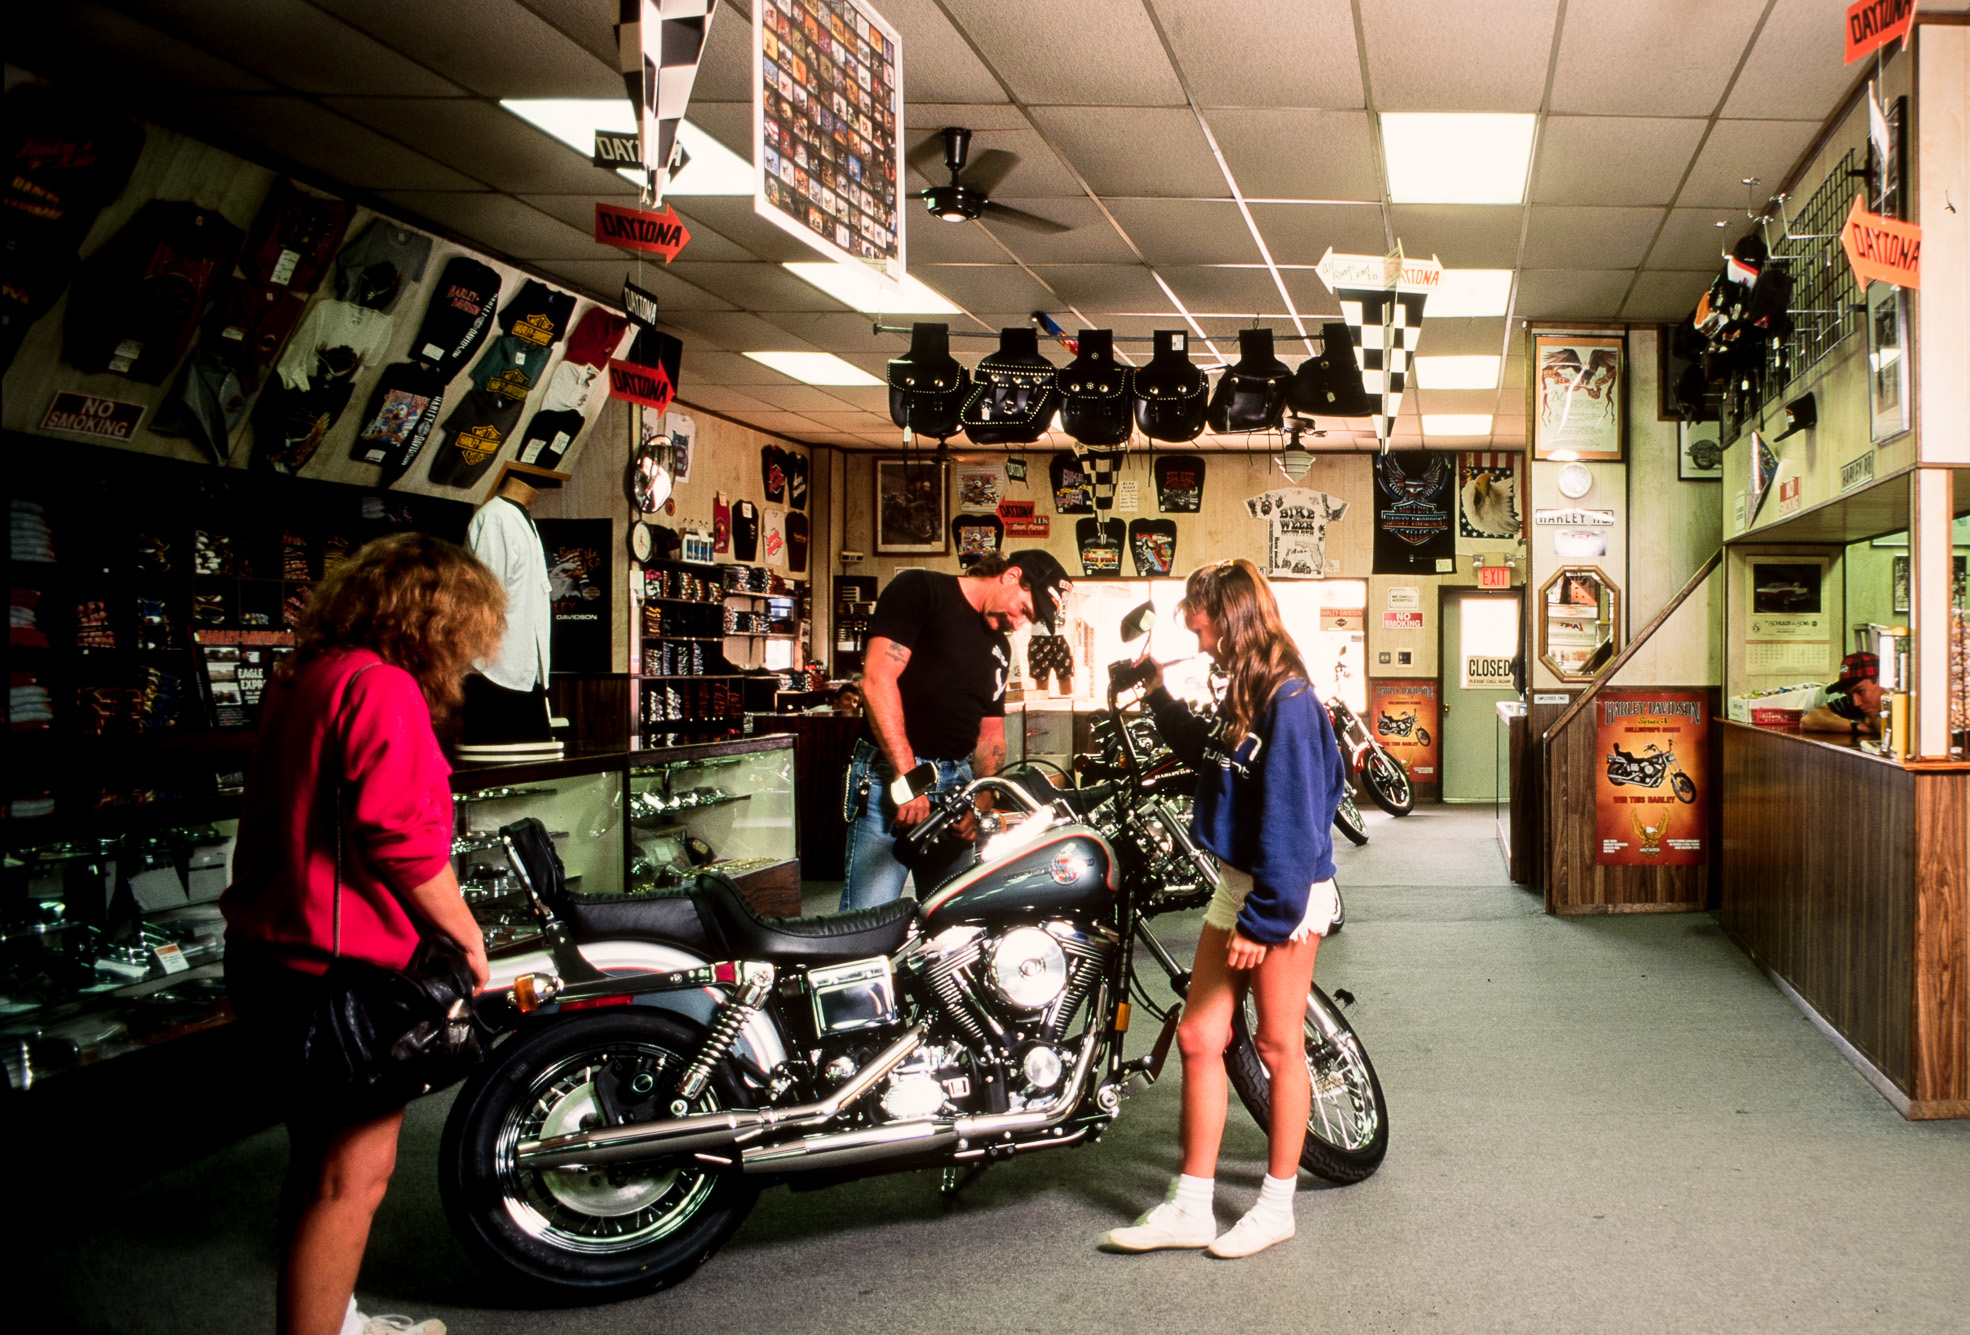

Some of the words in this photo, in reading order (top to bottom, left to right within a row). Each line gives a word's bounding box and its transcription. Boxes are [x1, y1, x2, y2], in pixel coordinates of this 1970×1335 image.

[1850, 0, 1912, 45] DAYTONA
[596, 136, 683, 167] DAYTA
[599, 212, 683, 247] DAYTONA
[1852, 222, 1921, 272] DAYTONA
[624, 286, 658, 326] DAYTONA
[611, 367, 668, 403] DAYTONA
[80, 397, 115, 418] NO
[47, 411, 128, 437] SMOKING
[1063, 468, 1085, 486] BIKE
[1000, 505, 1034, 518] DAYTONA
[1279, 506, 1316, 519] BIKE
[1482, 568, 1507, 586] EXIT
[237, 667, 264, 679] EAGLE
[1469, 659, 1511, 677] CLOSED
[240, 679, 267, 691] EXPR
[1604, 701, 1701, 725] HARLEY-DAVIDSON
[1637, 716, 1660, 725] Series
[1613, 796, 1628, 804] WIN
[1629, 796, 1646, 804] THIS
[1647, 796, 1676, 804] HARLEY
